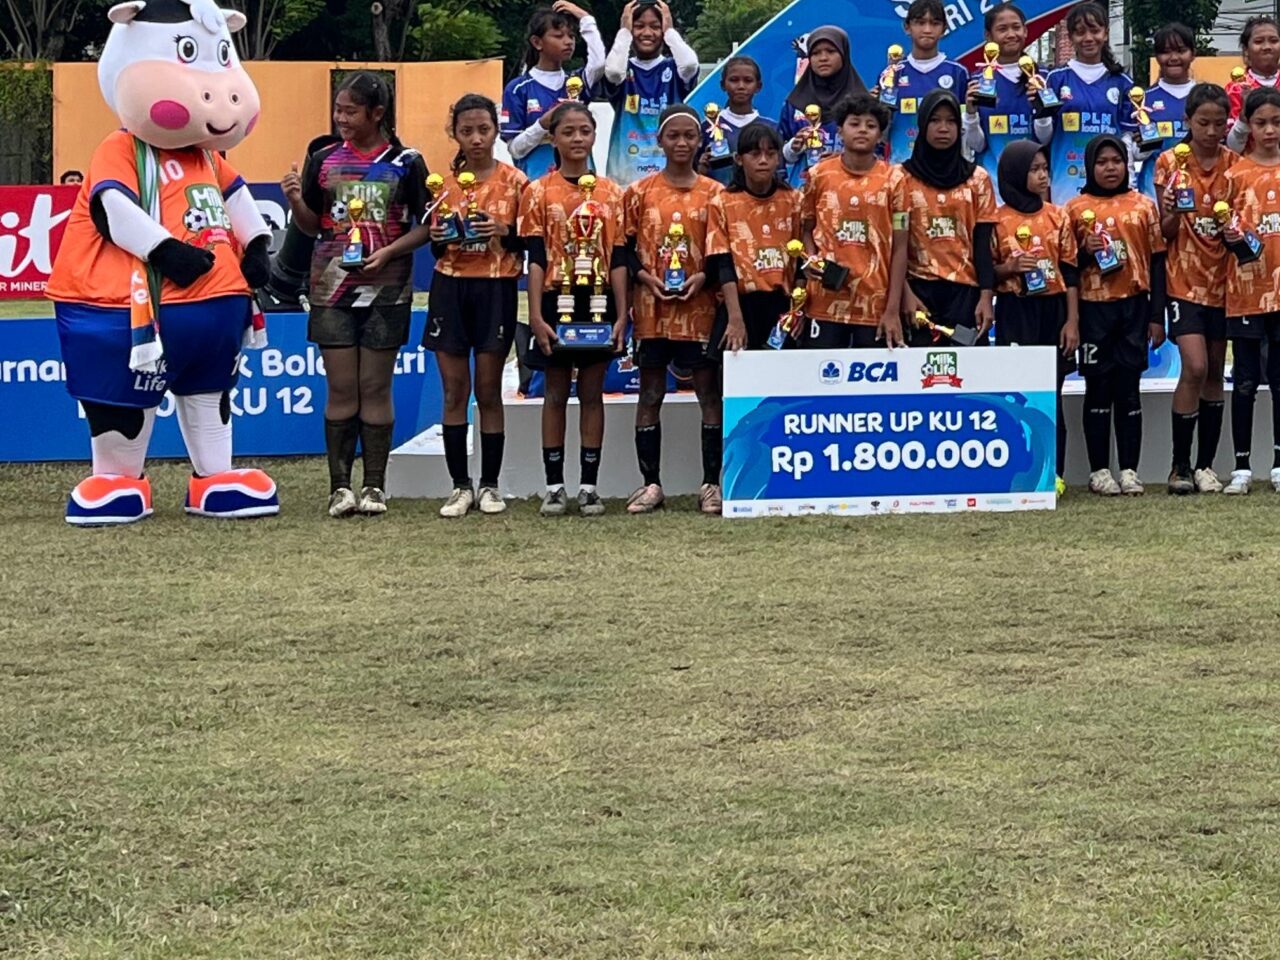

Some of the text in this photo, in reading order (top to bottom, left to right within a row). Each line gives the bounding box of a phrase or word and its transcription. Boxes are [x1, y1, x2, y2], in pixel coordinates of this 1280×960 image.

[1081, 112, 1112, 125] PLN
[342, 184, 384, 204] Milk
[843, 220, 866, 232] Milk
[846, 230, 867, 243] Life
[930, 353, 955, 365] Milk
[1082, 342, 1099, 365] 12
[847, 361, 898, 383] BCA
[934, 364, 956, 376] Life
[133, 375, 167, 392] Life
[276, 386, 314, 415] 12
[784, 409, 997, 435] RUNNER UP KU 12
[771, 438, 1010, 480] Rp 1.800.000
